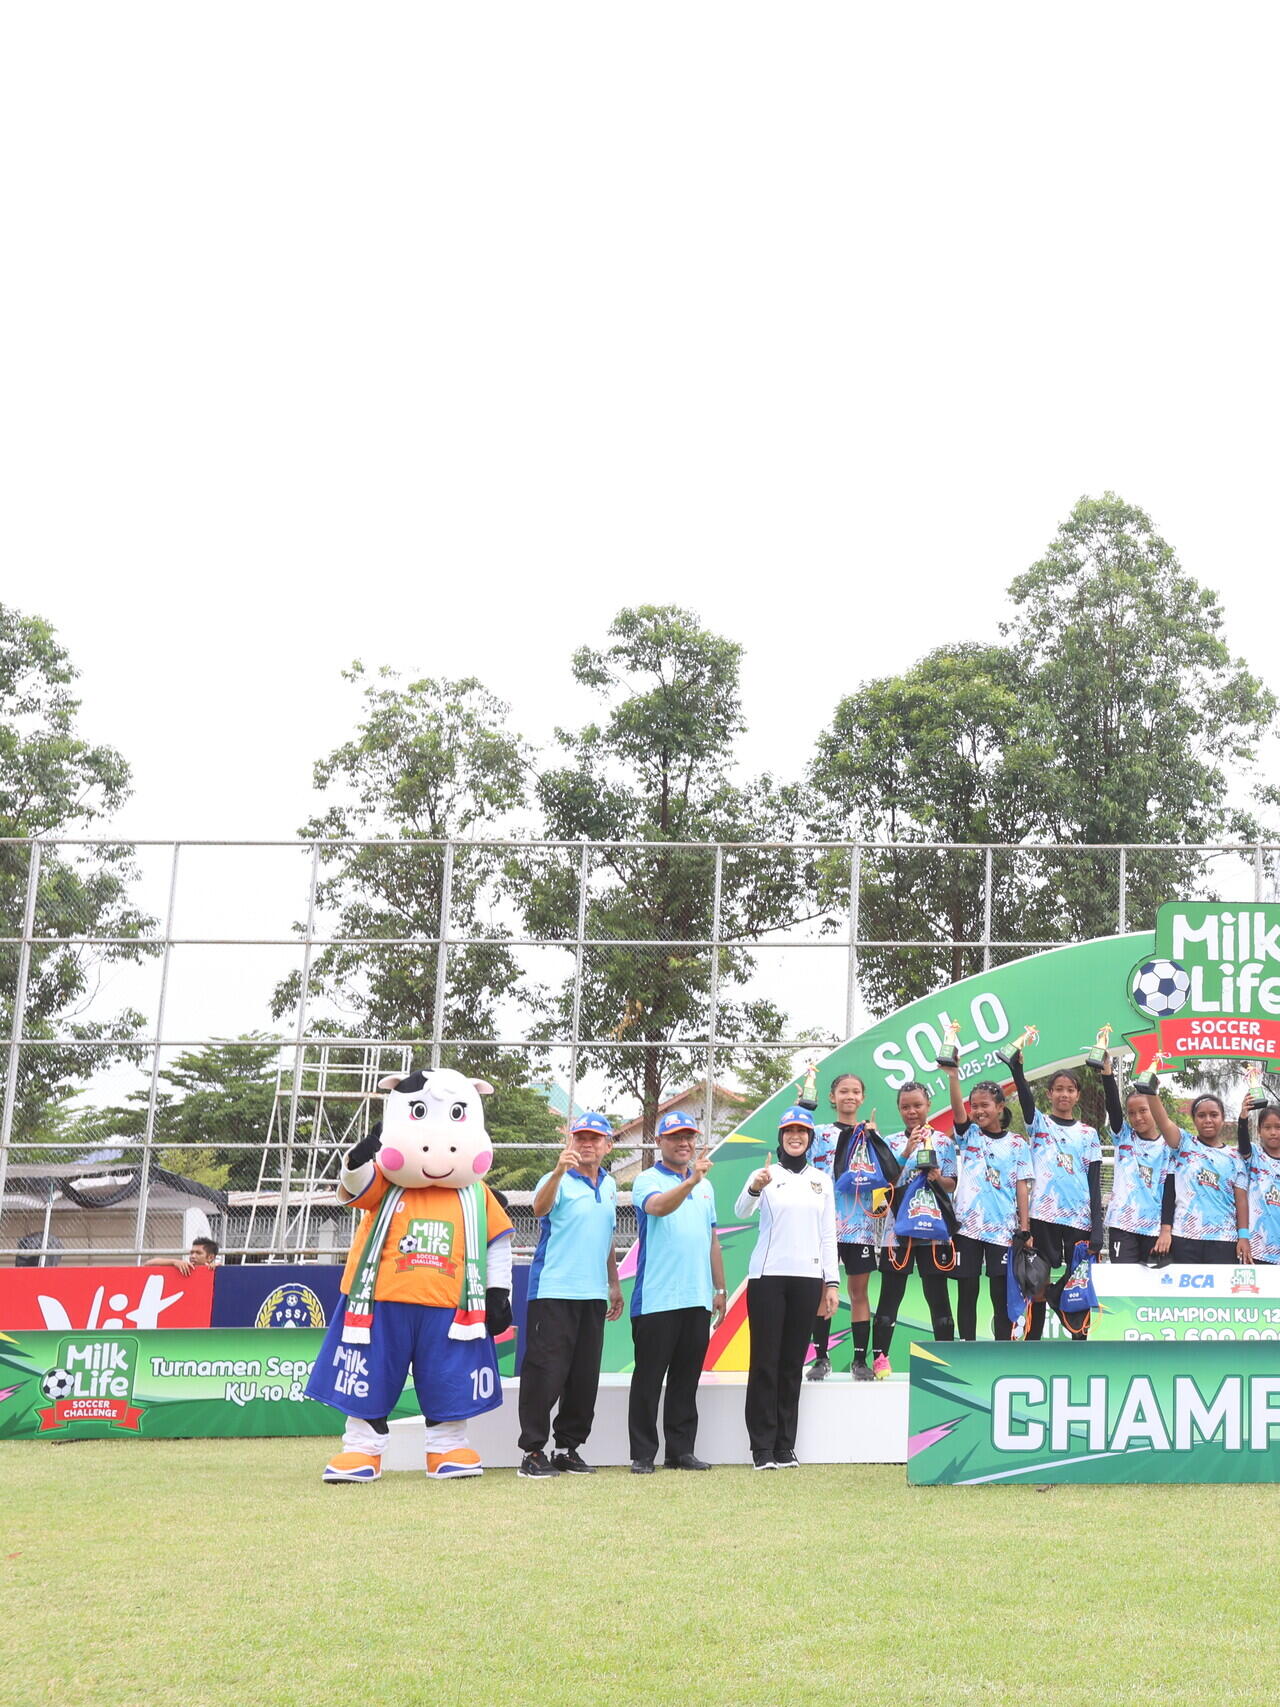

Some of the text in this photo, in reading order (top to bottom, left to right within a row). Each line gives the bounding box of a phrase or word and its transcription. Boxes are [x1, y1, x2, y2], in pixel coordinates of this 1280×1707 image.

[1191, 1020, 1261, 1036] SOCCER
[873, 992, 1009, 1091] SOLO
[1176, 1037, 1277, 1053] CHALLENGE
[413, 1221, 449, 1240] Milk
[417, 1236, 449, 1255] Life
[411, 1259, 443, 1267] CHALLENGE
[1179, 1274, 1214, 1288] BCA
[275, 1308, 307, 1322] PSSI
[1136, 1307, 1231, 1323] CHAMPION
[1234, 1308, 1259, 1323] KU
[66, 1343, 129, 1371] Milk
[333, 1346, 368, 1376] Milk
[151, 1357, 261, 1377] Turnamen
[73, 1370, 129, 1398] Life
[334, 1370, 369, 1398] Life
[470, 1367, 494, 1400] 10
[225, 1382, 306, 1407] KU 10 &
[63, 1409, 117, 1418] CHALLENGE
[72, 1401, 110, 1409] SOCCER
